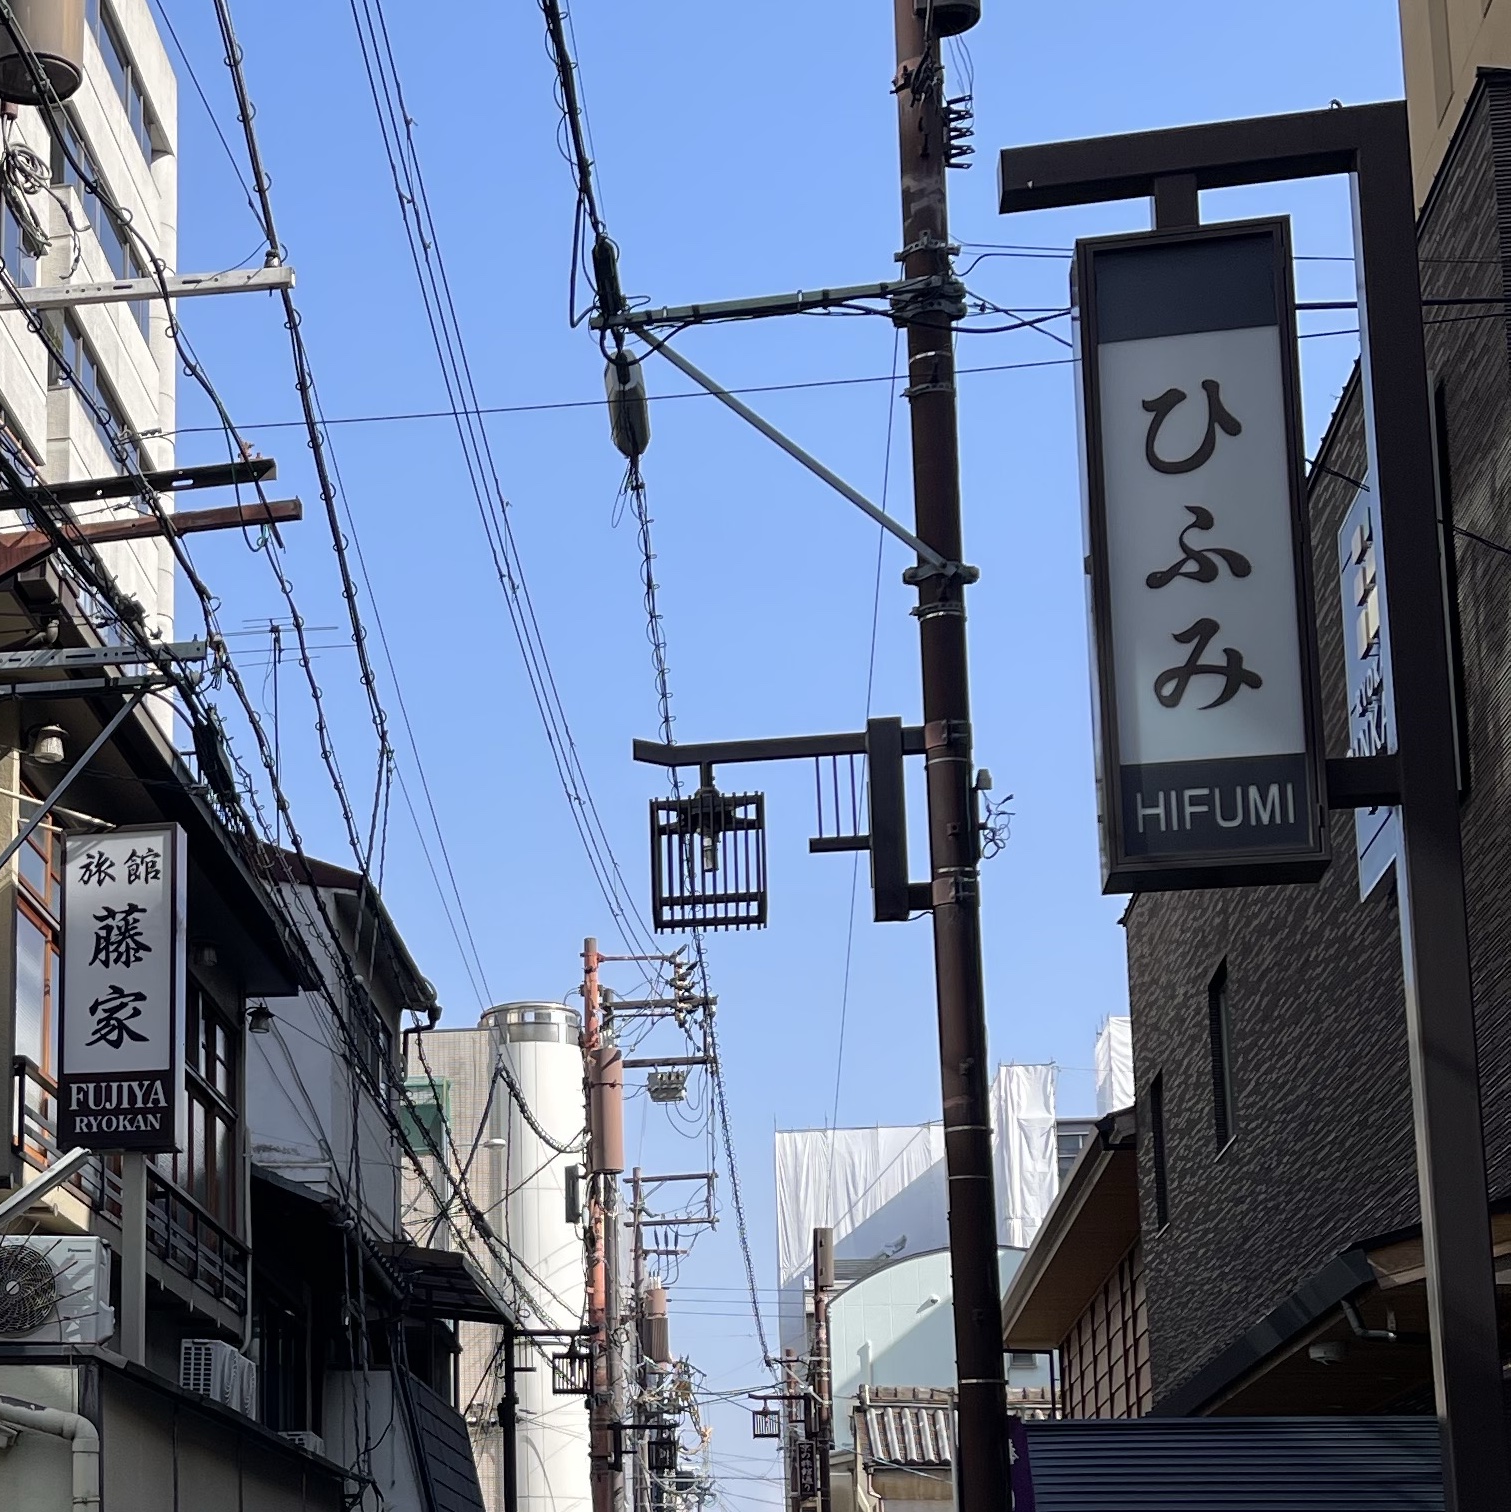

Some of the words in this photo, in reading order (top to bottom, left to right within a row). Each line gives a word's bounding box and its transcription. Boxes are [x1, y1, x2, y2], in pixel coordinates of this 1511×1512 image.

[1141, 378, 1264, 711] ひふみ
[1135, 781, 1296, 833] HIFUMI
[77, 847, 163, 887] 旅館
[85, 902, 153, 1050] 藤家
[68, 1079, 169, 1111] FUJIYA
[73, 1112, 162, 1134] RYOKAN
